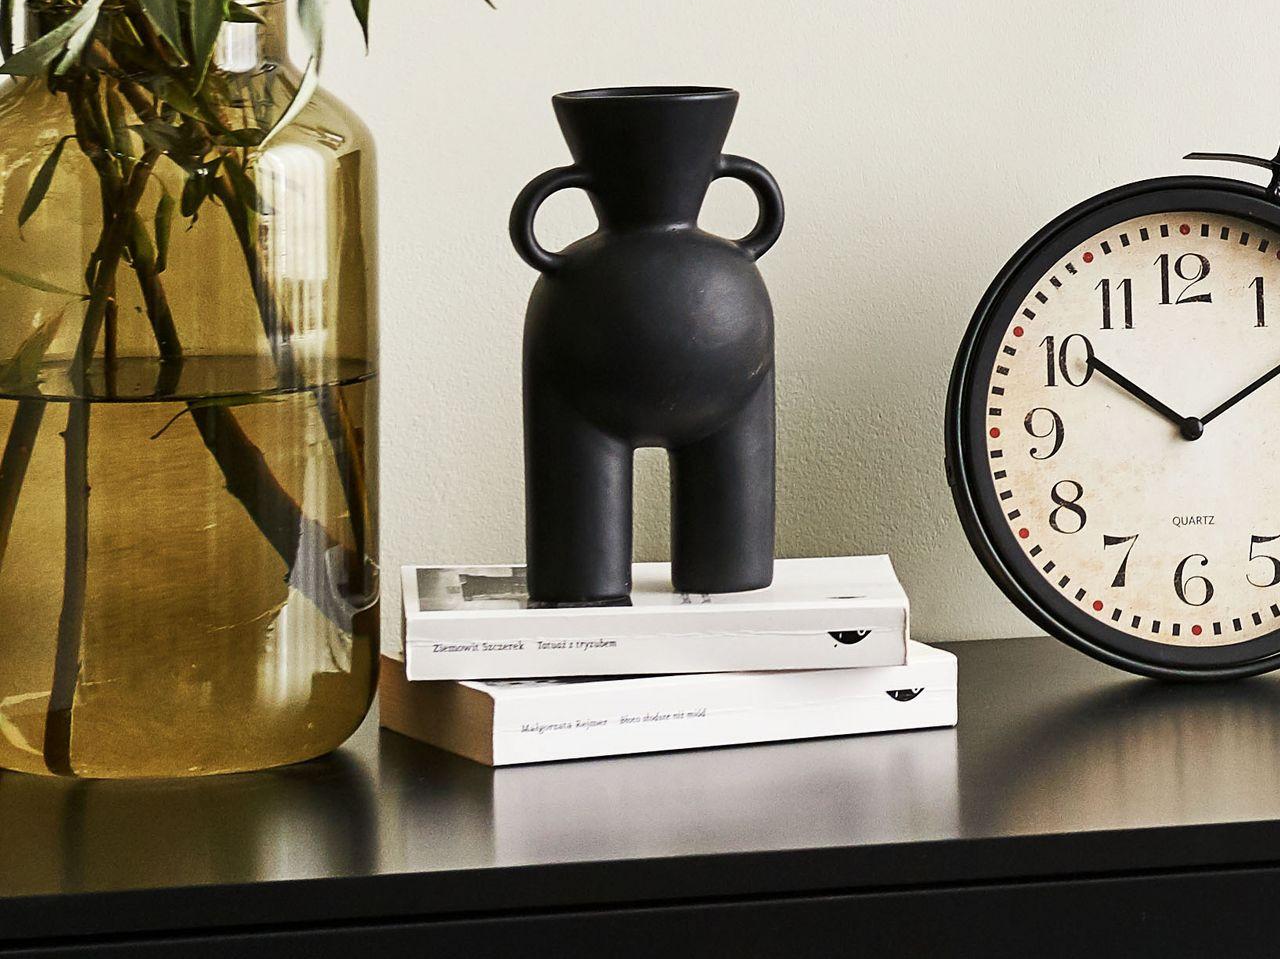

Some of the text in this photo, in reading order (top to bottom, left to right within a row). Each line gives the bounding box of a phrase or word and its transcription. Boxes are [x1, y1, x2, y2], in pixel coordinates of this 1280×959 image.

[1094, 278, 1136, 330] 11
[1153, 253, 1213, 306] 12
[1247, 276, 1269, 328] 1
[1038, 333, 1096, 388] 10
[1023, 407, 1066, 461] 9
[1048, 479, 1088, 535] 8
[1172, 515, 1215, 527] QUARTZ
[1103, 533, 1140, 588] 7
[1173, 553, 1215, 607] 6
